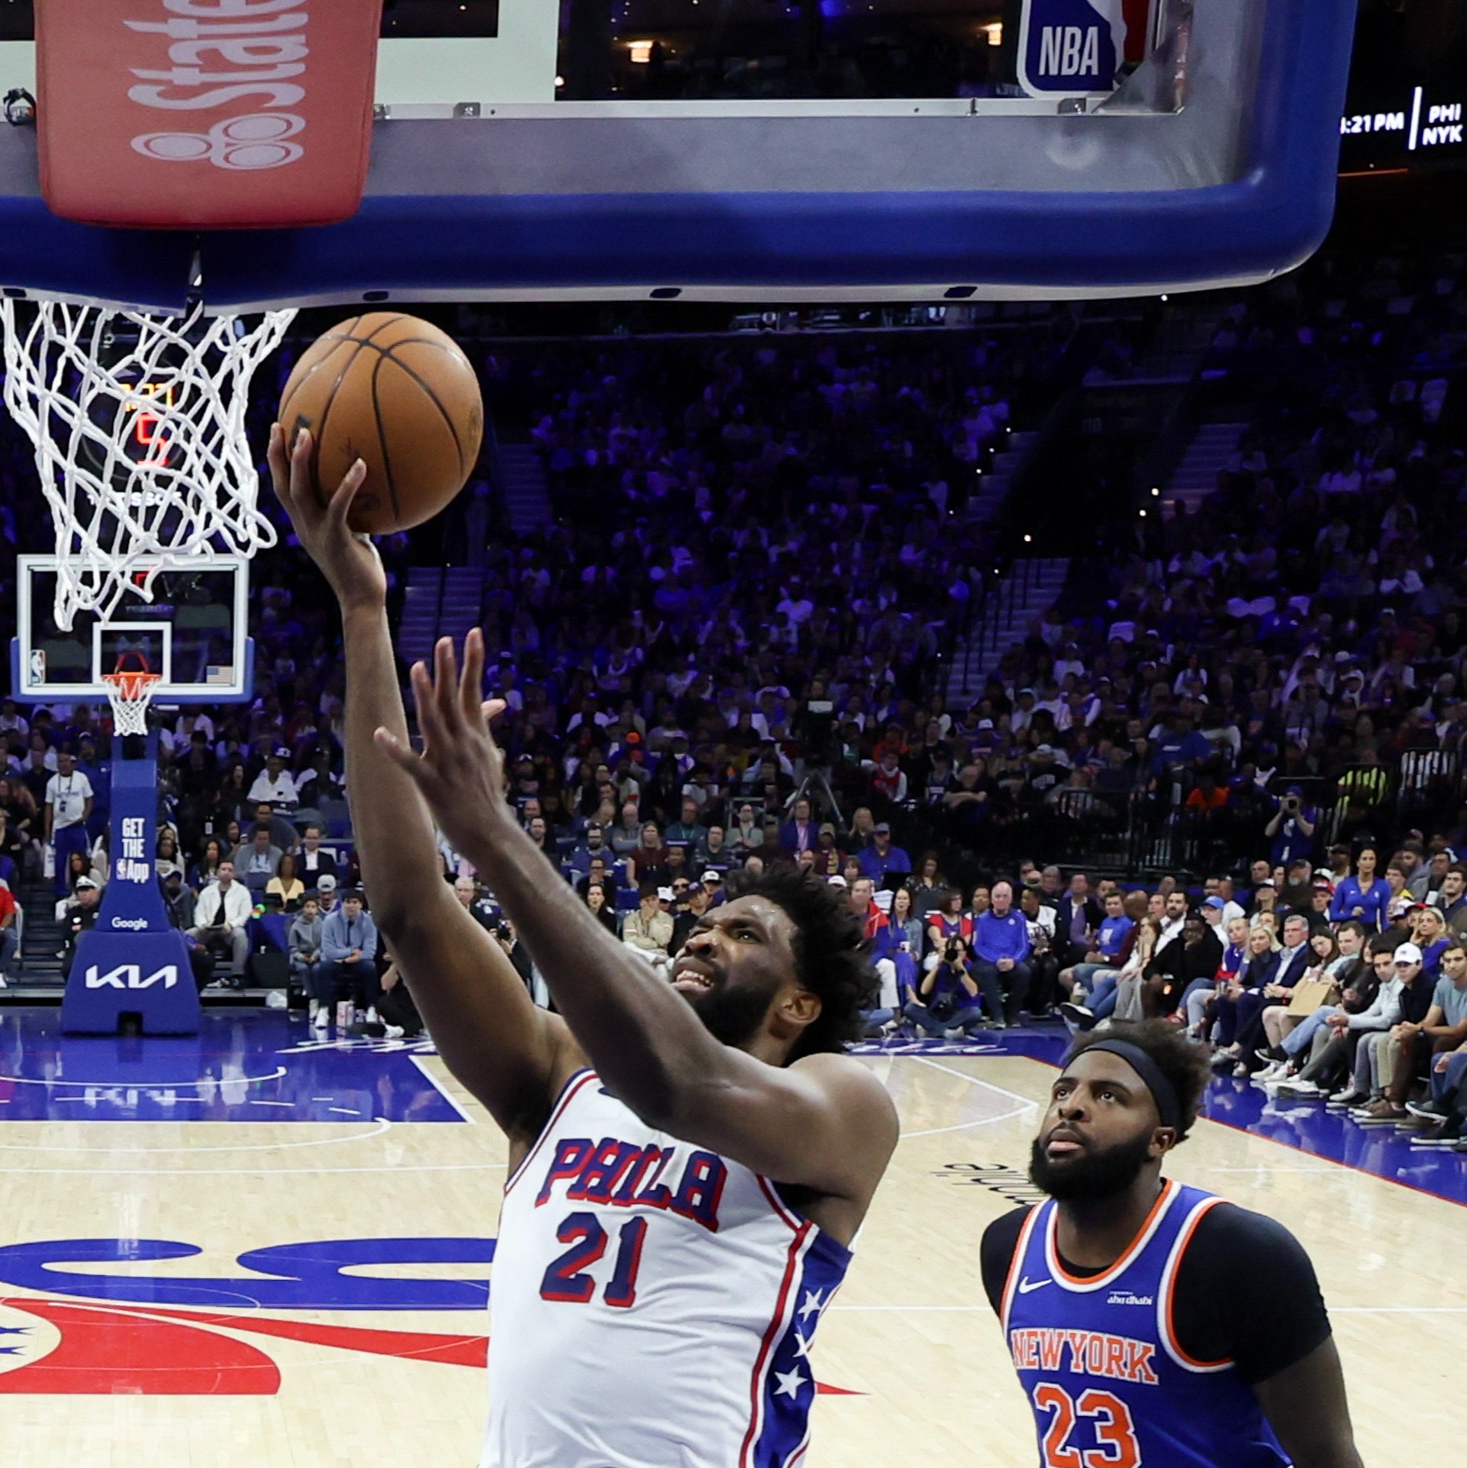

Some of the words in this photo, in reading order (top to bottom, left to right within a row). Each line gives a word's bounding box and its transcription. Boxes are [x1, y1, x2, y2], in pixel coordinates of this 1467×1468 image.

[1038, 26, 1099, 76] NBA
[1374, 112, 1405, 132] PM
[1429, 103, 1462, 123] PHI
[1422, 125, 1463, 145] NYK
[122, 817, 145, 837] GET
[121, 838, 145, 858] THE
[126, 860, 150, 883] App
[111, 917, 148, 930] Google
[85, 964, 178, 989] KIA
[534, 1137, 728, 1234] PHILA
[540, 1212, 648, 1308] 21
[1010, 1328, 1065, 1371] NEW
[1065, 1329, 1160, 1386] YORK
